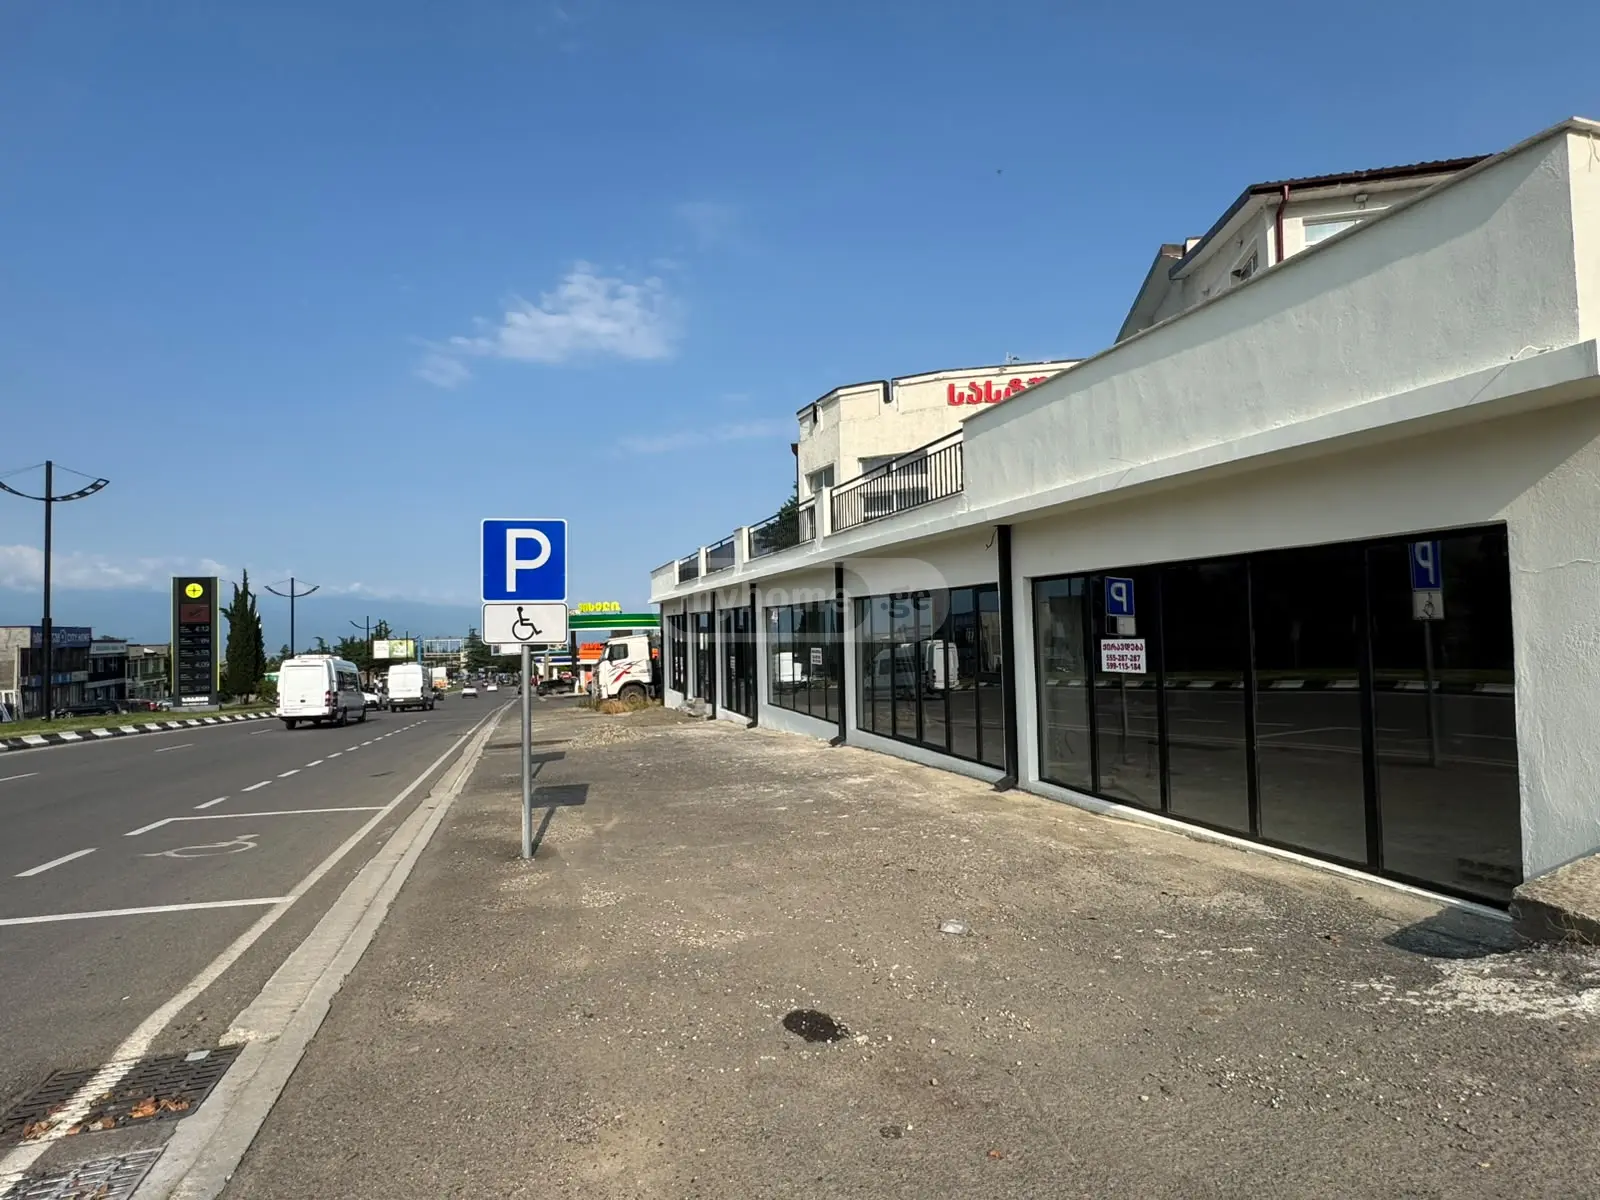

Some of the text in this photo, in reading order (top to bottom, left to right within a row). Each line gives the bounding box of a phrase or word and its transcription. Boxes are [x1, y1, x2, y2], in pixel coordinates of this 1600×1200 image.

[948, 376, 1048, 406] სასტ
[506, 528, 551, 592] P
[1102, 643, 1144, 651] ქირავდება
